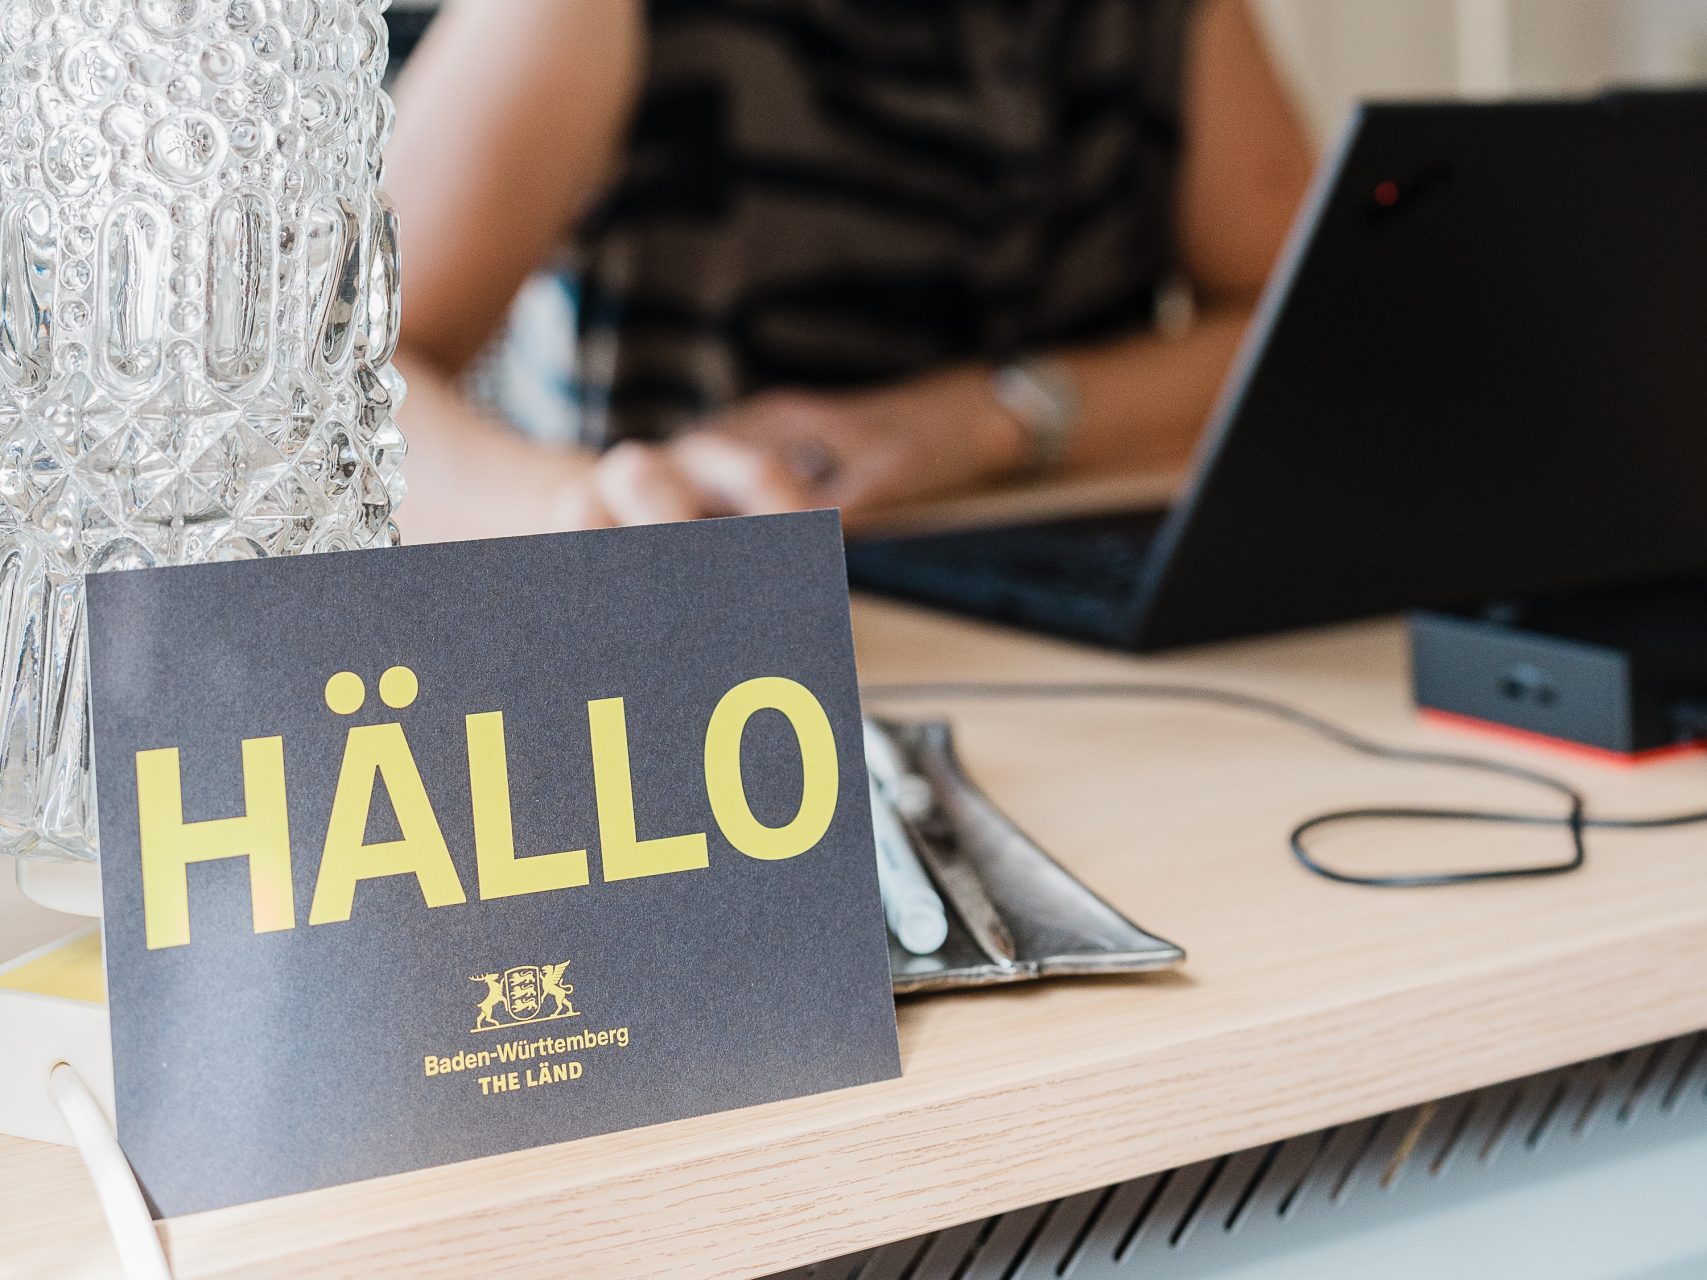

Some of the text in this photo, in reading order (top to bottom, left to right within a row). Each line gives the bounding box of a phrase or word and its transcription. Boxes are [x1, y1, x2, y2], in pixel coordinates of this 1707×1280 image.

[136, 666, 839, 950] HÄLLO
[424, 1027, 630, 1077] Baden-Württemberg
[478, 1061, 583, 1095] THE LÄND
